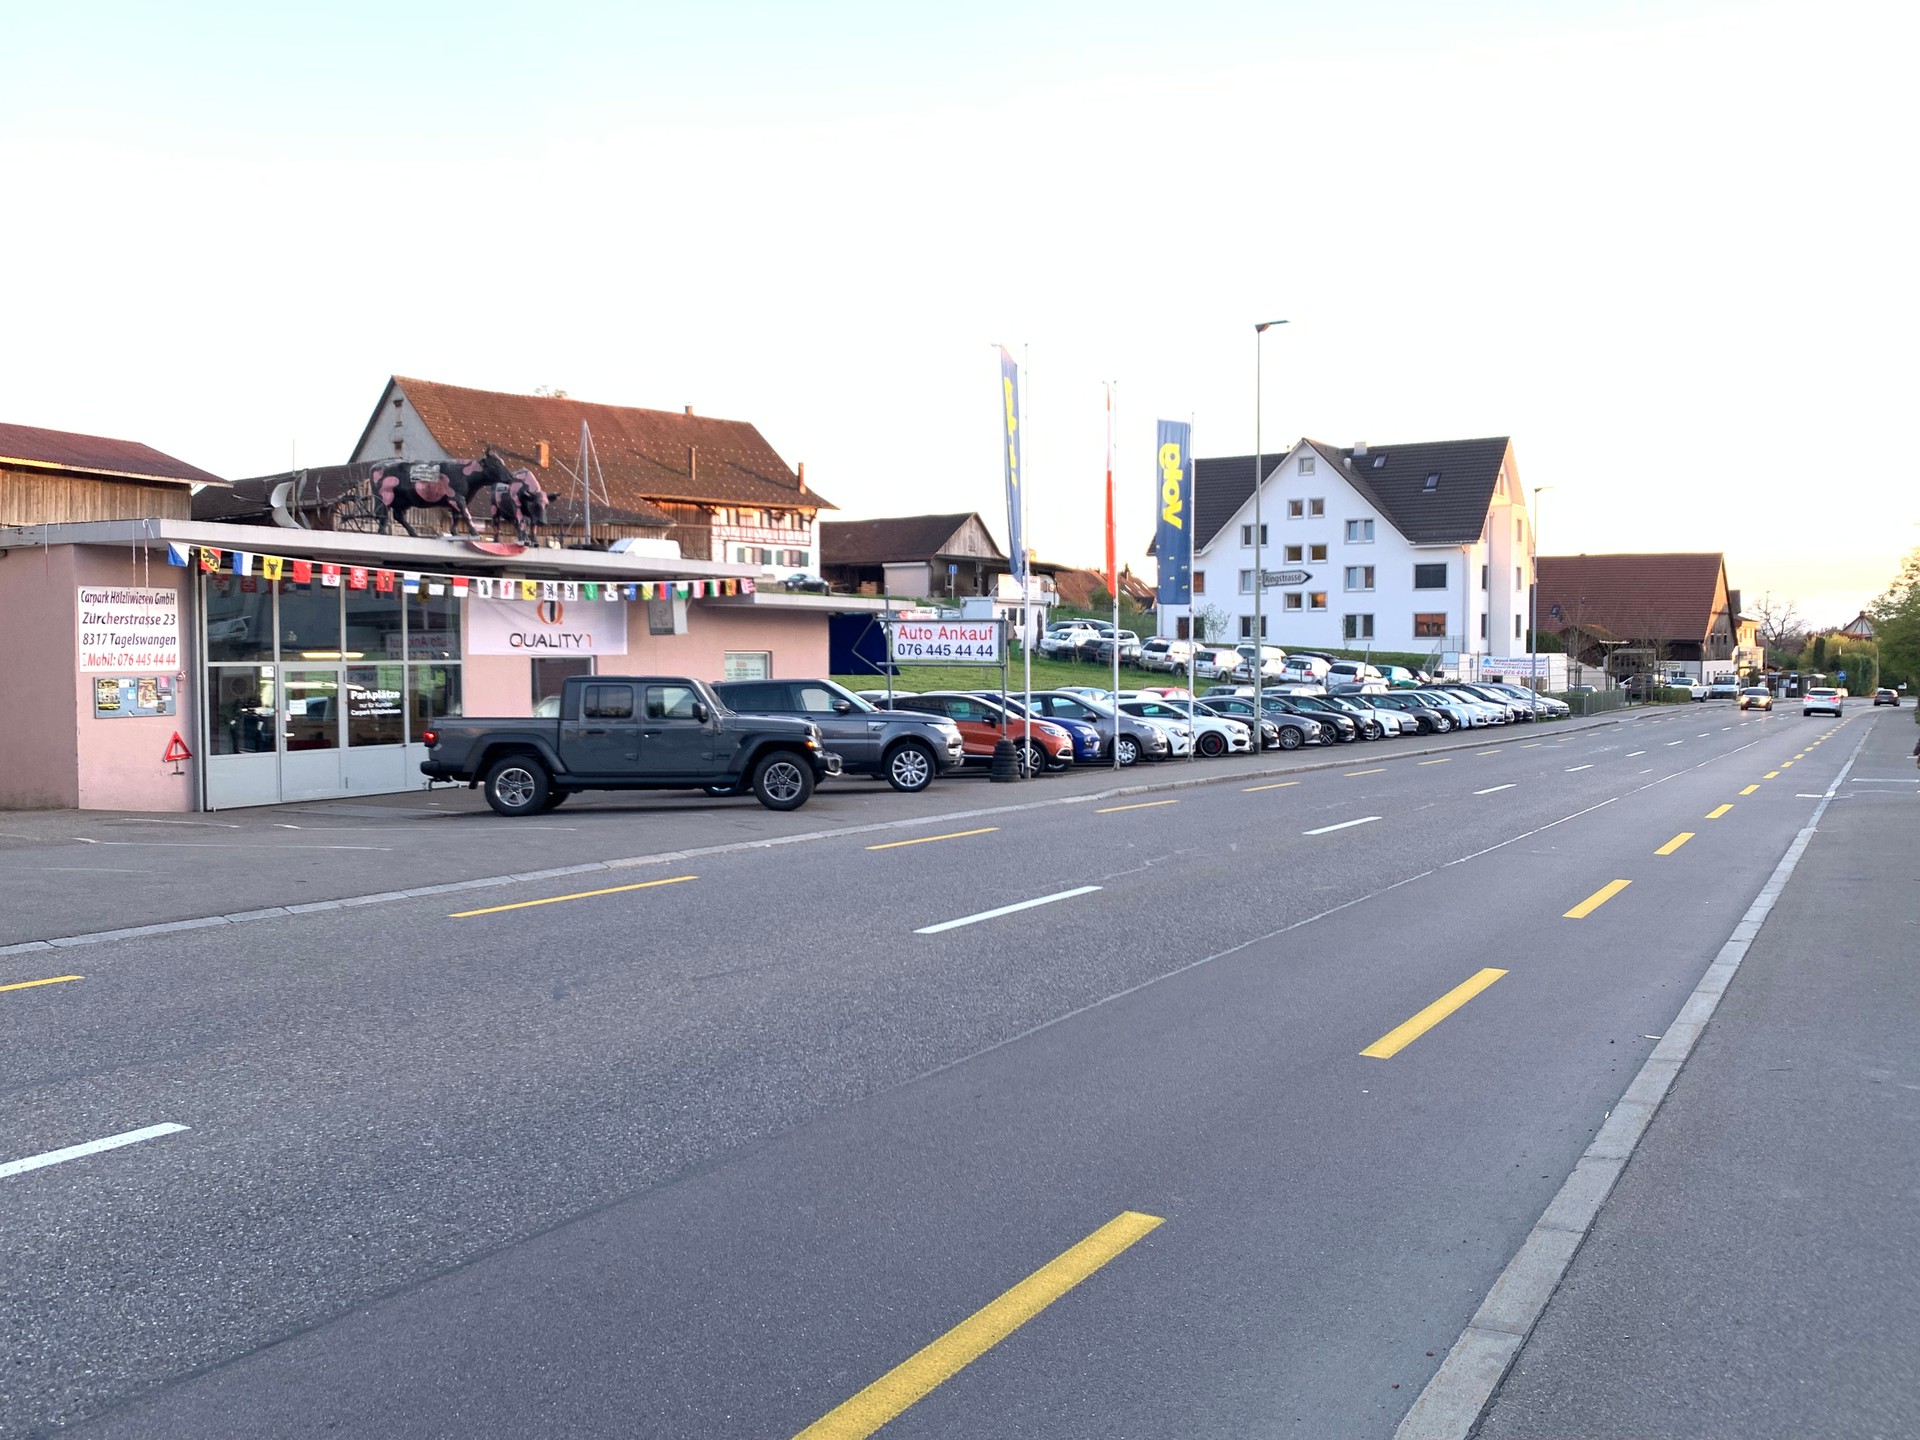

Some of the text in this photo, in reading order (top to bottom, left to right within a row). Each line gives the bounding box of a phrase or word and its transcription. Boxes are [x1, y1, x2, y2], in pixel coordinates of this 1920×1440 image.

[1265, 574, 1302, 585] Ringstrasse
[81, 590, 175, 606] Carpark Hölzliwiesen GmbH
[82, 611, 176, 626] Zürcherstrasse 23
[82, 632, 176, 648] 8317 Tagelswangen
[509, 632, 592, 648] QUALITY 1
[898, 624, 994, 641] Auto Ankauf
[897, 643, 993, 657] 076 445 44 44
[87, 652, 176, 666] Mobil: 076 445 44 44
[350, 689, 400, 701] Parkplätze
